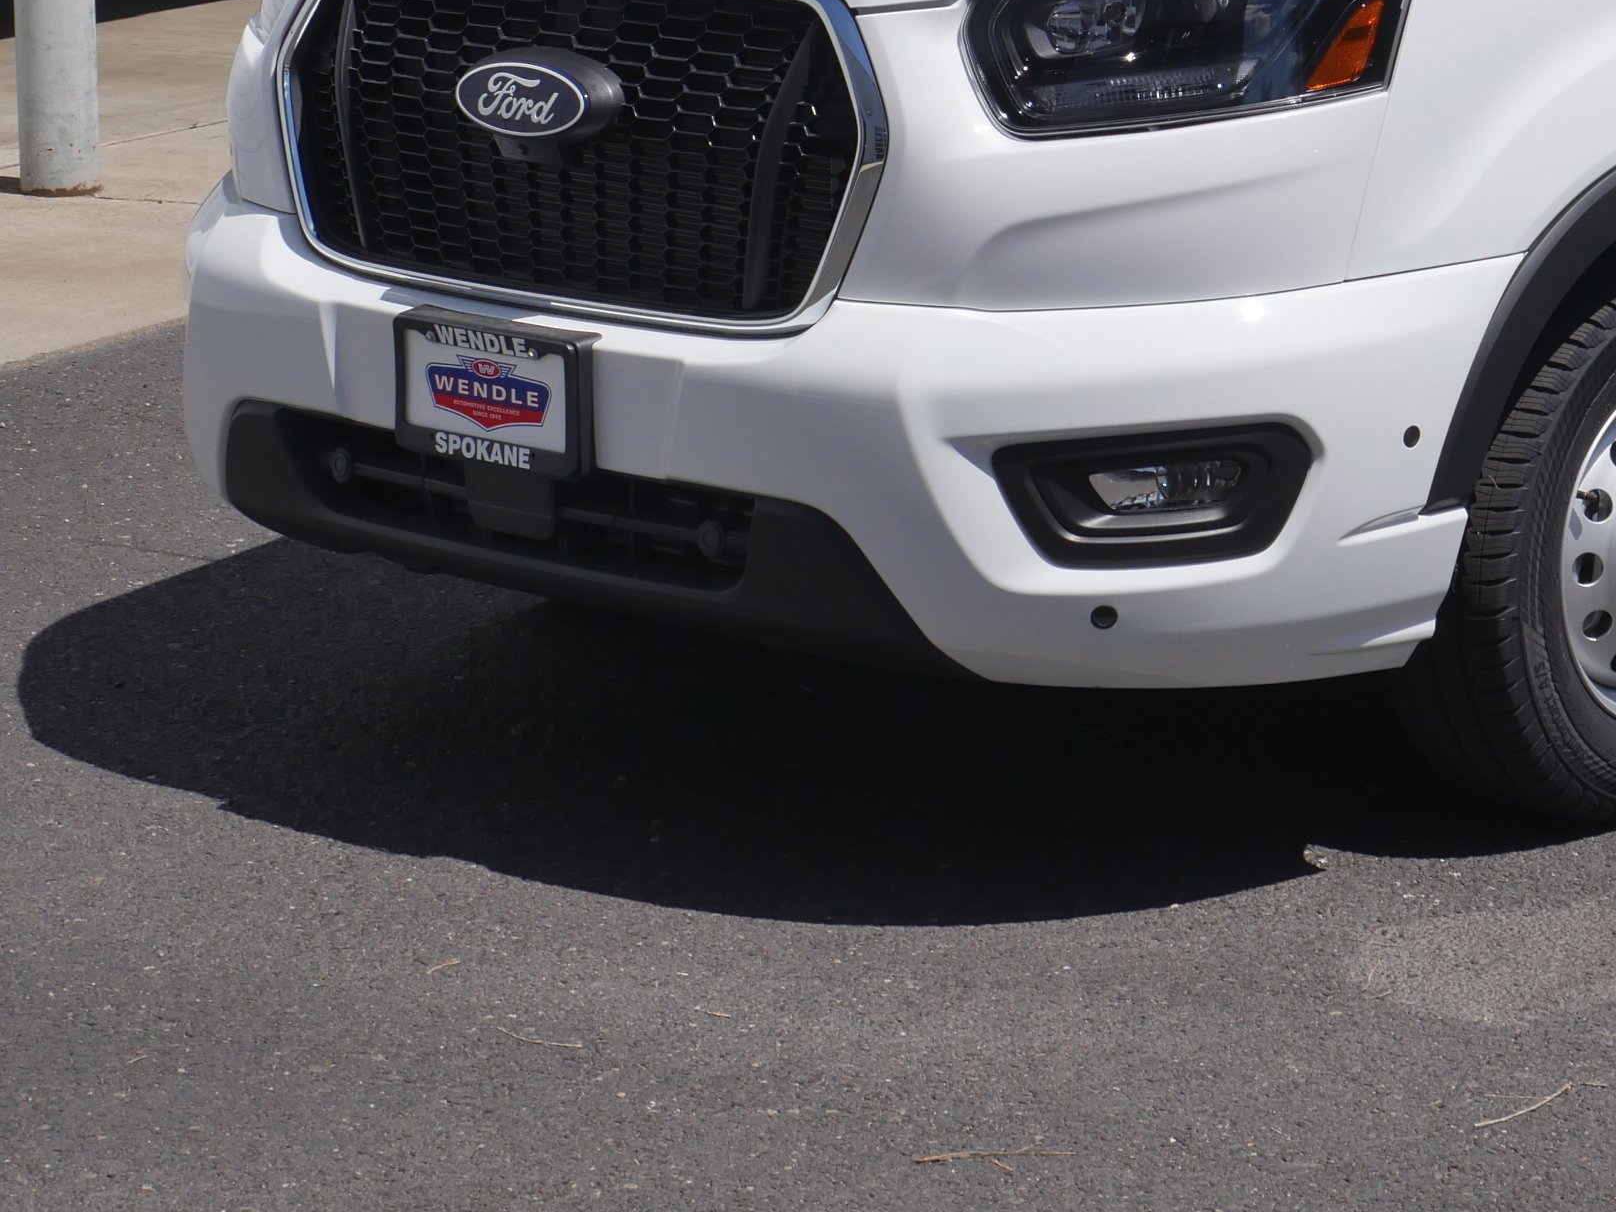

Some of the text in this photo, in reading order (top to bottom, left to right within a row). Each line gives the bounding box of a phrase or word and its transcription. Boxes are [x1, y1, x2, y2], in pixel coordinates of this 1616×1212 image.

[477, 72, 559, 125] Ford
[434, 324, 529, 358] WENDLE
[434, 374, 539, 408] WENDLE
[453, 399, 520, 416] AUTOMOTIVE EXCELLENCE
[435, 431, 531, 470] SPOKANE
